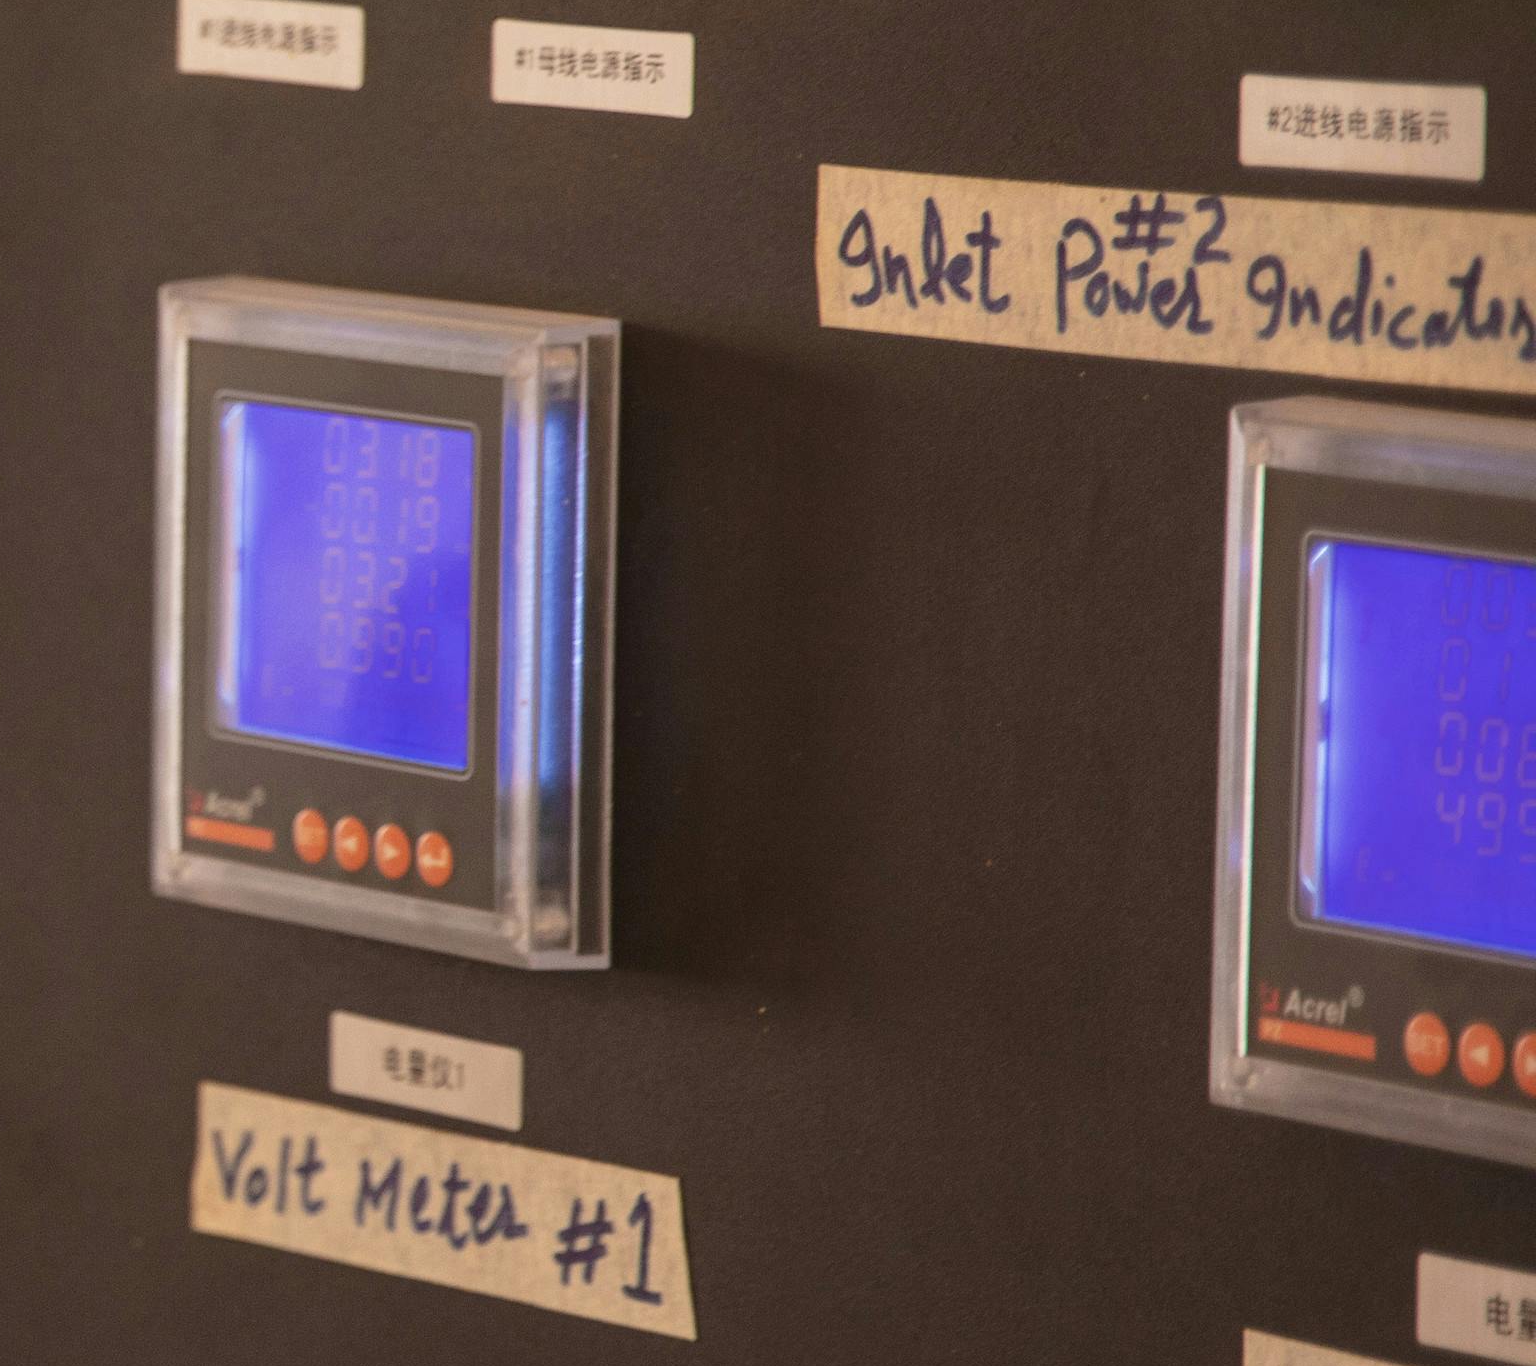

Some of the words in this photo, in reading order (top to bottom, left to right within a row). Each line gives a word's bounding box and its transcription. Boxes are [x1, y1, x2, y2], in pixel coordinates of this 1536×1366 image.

[1267, 103, 1452, 146] #2进线电源指示
[838, 197, 1012, 315] Inlet
[1055, 217, 1215, 336] Power
[1112, 192, 1232, 263] #2
[212, 1131, 326, 1215] Volt
[355, 1156, 530, 1253] Meter
[552, 1191, 665, 1307] #1
